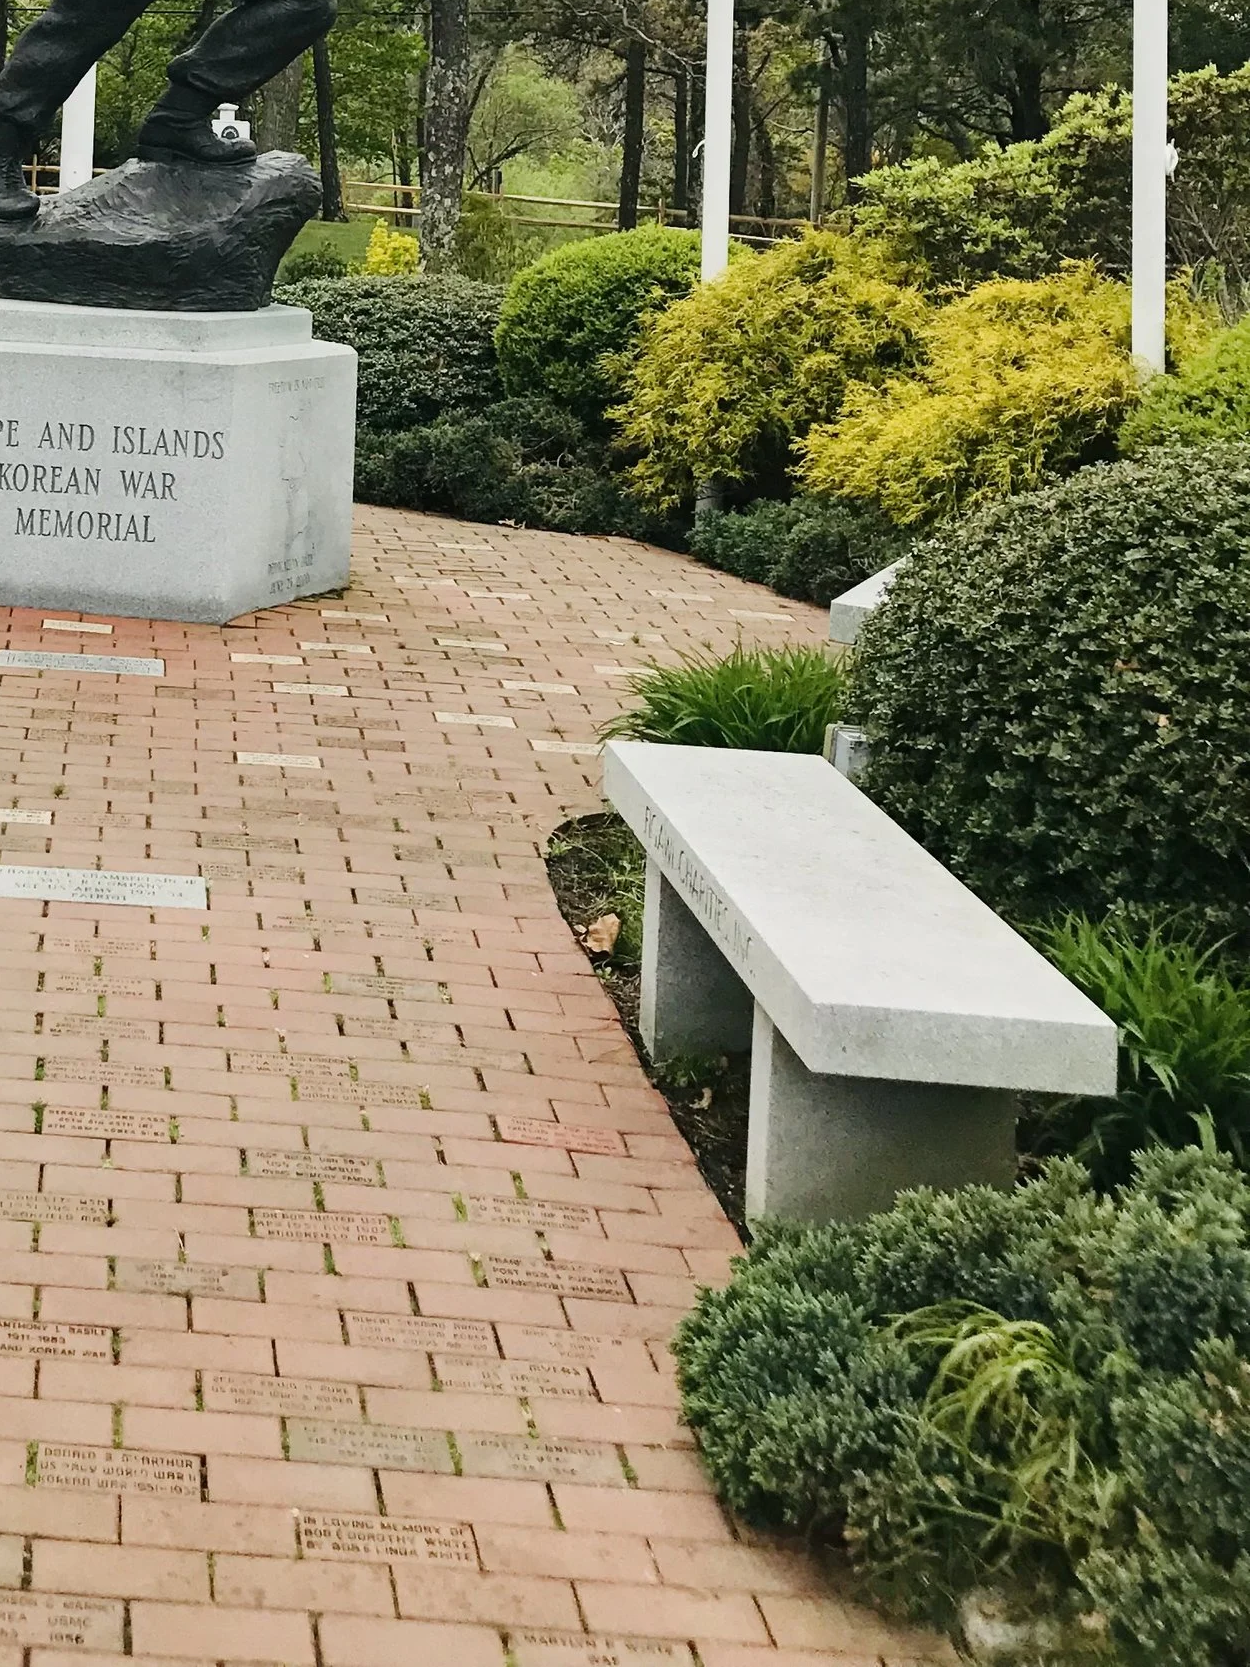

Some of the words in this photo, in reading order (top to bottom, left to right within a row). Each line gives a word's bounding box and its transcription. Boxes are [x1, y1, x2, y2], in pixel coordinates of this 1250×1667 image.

[37, 421, 95, 452] AND
[111, 425, 225, 460] ISLANDS
[119, 469, 178, 501] WAR
[14, 507, 156, 543] MEMORIAL
[0, 1343, 24, 1353] AND
[28, 1345, 77, 1357] KOREAN
[82, 1350, 107, 1359] WAR
[37, 1474, 91, 1487] KOREAN
[153, 1470, 185, 1481] WAR
[303, 1516, 317, 1525] IN
[322, 1517, 374, 1530] LOVING
[379, 1521, 441, 1535] MEMORY
[347, 1530, 415, 1545] DOROTHY
[424, 1537, 469, 1549] WHITE
[427, 1550, 473, 1562] WHITE
